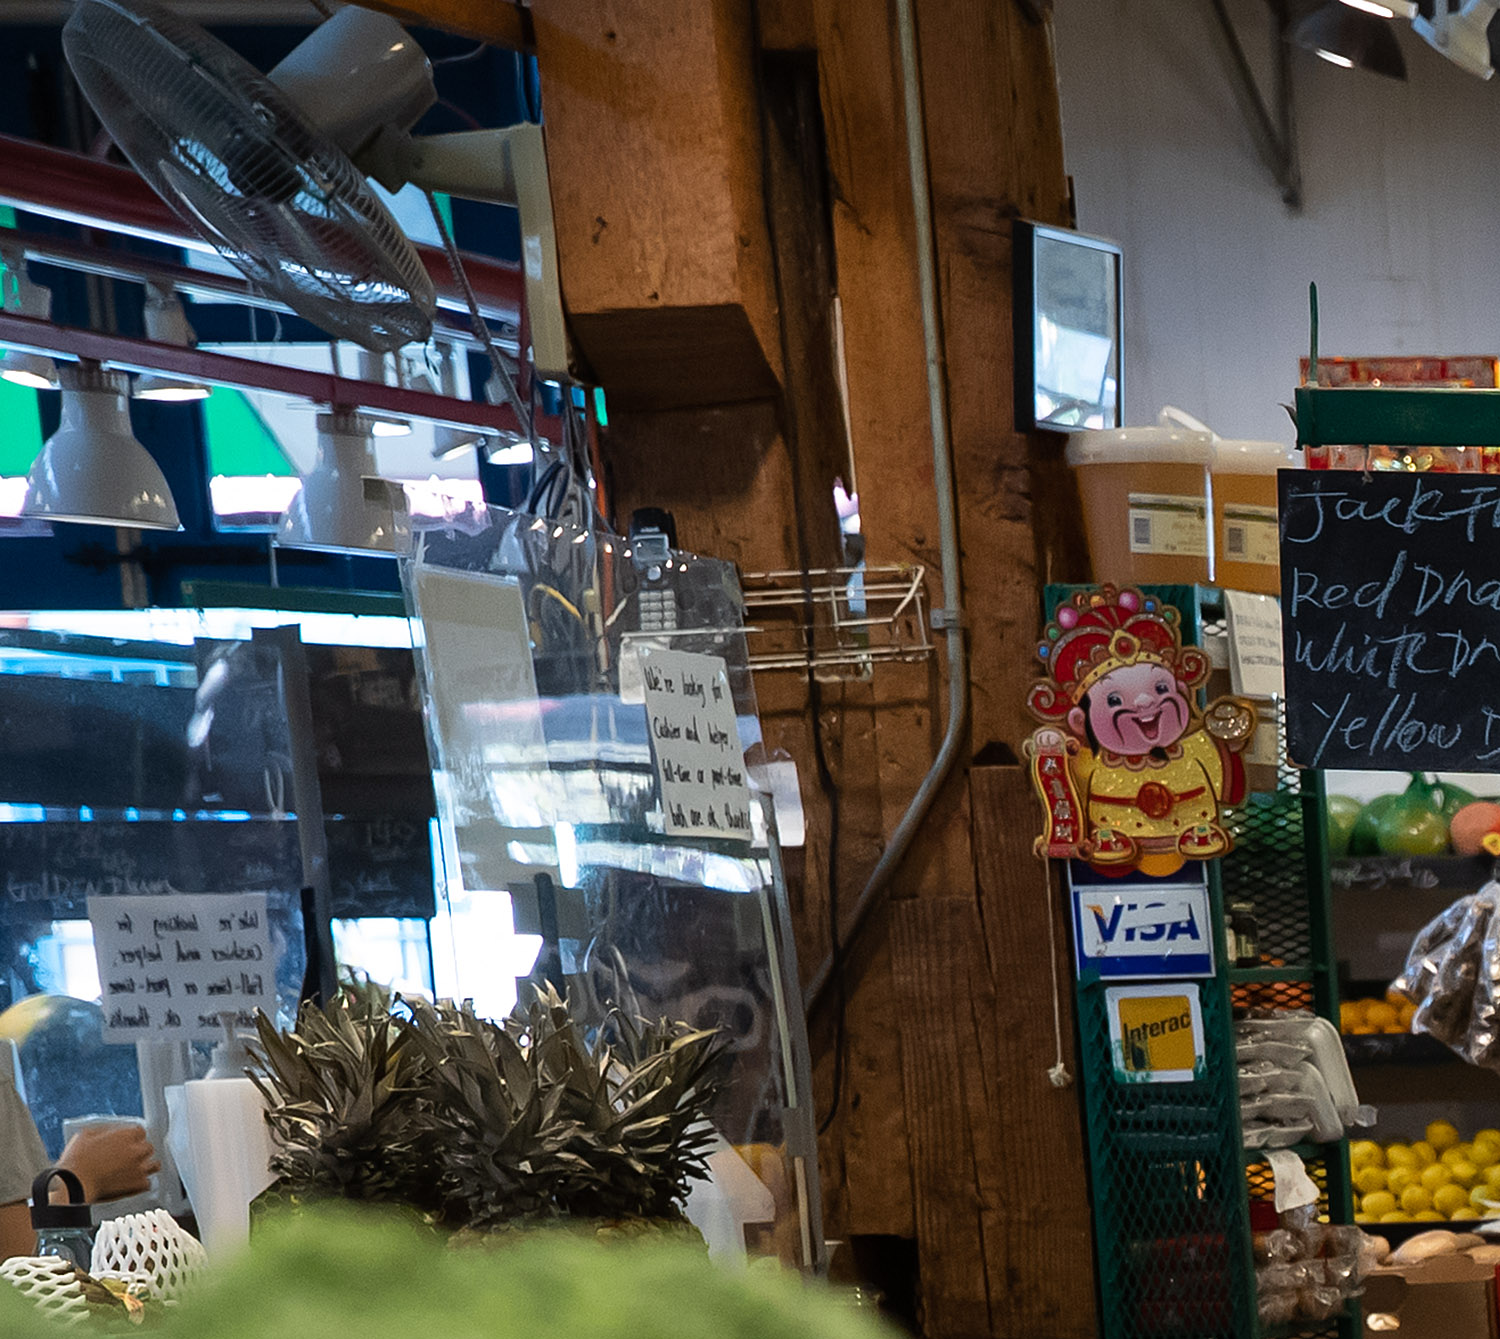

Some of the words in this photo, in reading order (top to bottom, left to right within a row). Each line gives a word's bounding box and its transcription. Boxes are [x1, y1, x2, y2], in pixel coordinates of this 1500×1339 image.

[1290, 550, 1408, 619] Red
[1295, 621, 1442, 690] White
[1311, 692, 1464, 770] Yellow
[1122, 1007, 1193, 1046] Interac
